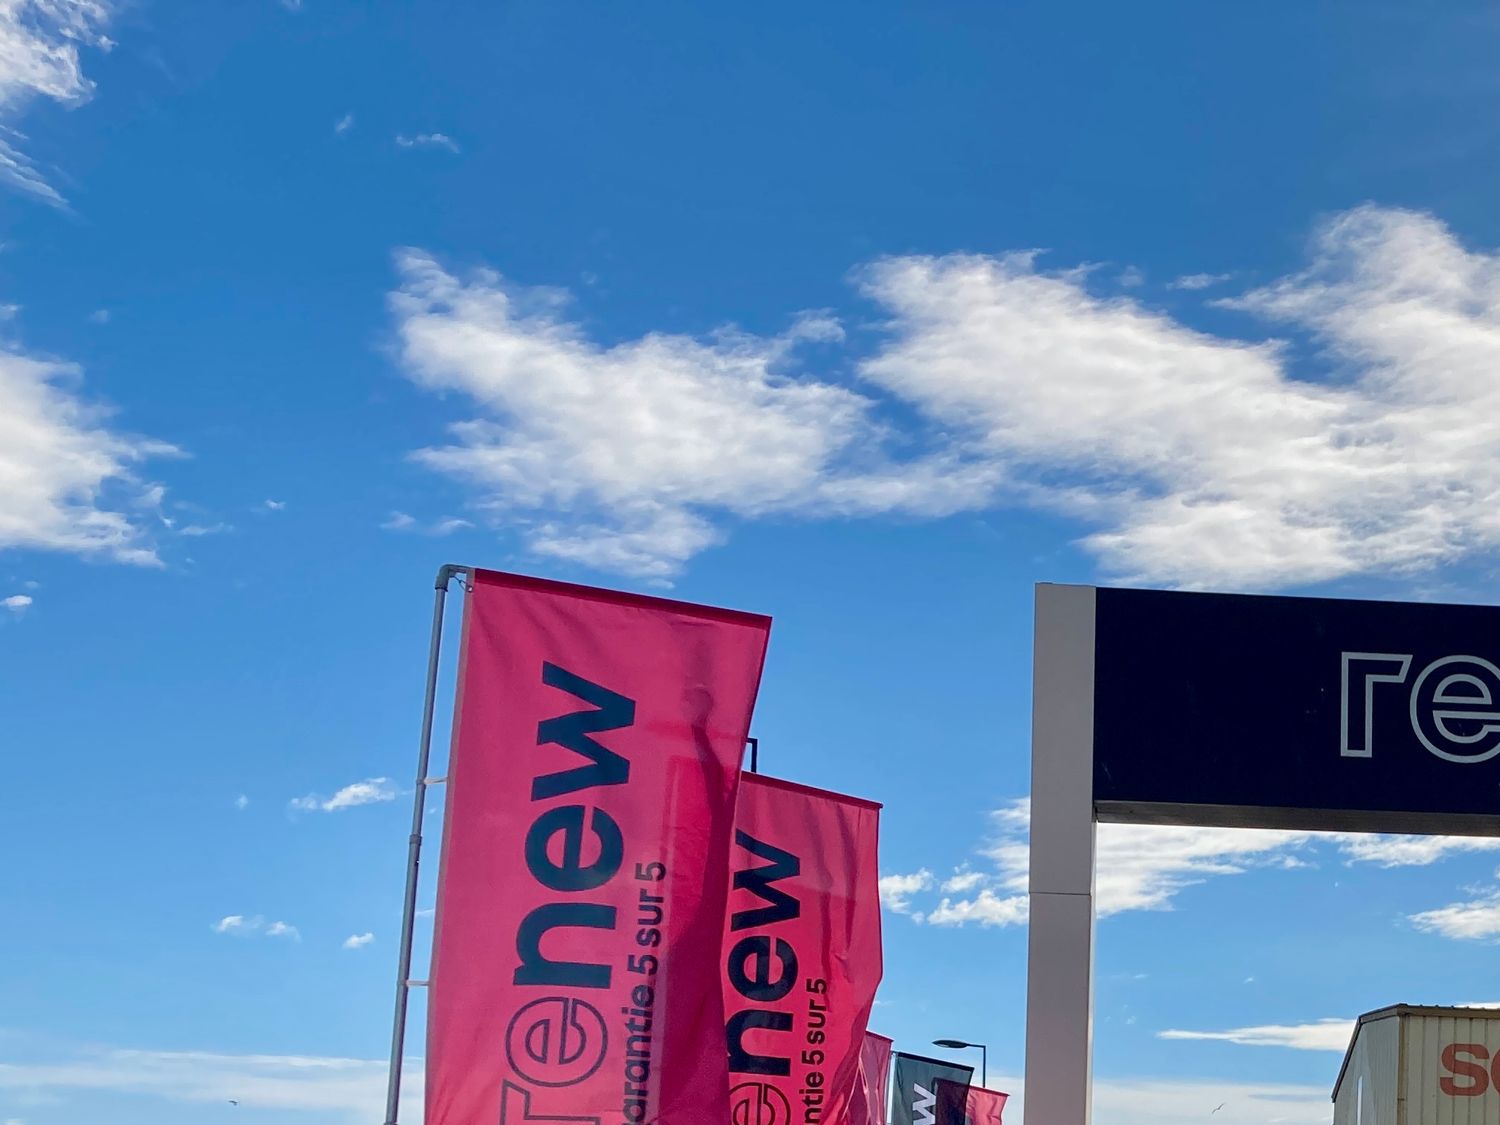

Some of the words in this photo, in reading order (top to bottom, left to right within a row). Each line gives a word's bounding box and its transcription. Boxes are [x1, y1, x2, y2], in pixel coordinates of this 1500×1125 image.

[634, 861, 667, 882] 5
[635, 888, 664, 948] sur
[627, 953, 657, 976] 5
[806, 978, 828, 995] 5
[806, 1000, 827, 1045] sur
[801, 1049, 825, 1066] 5
